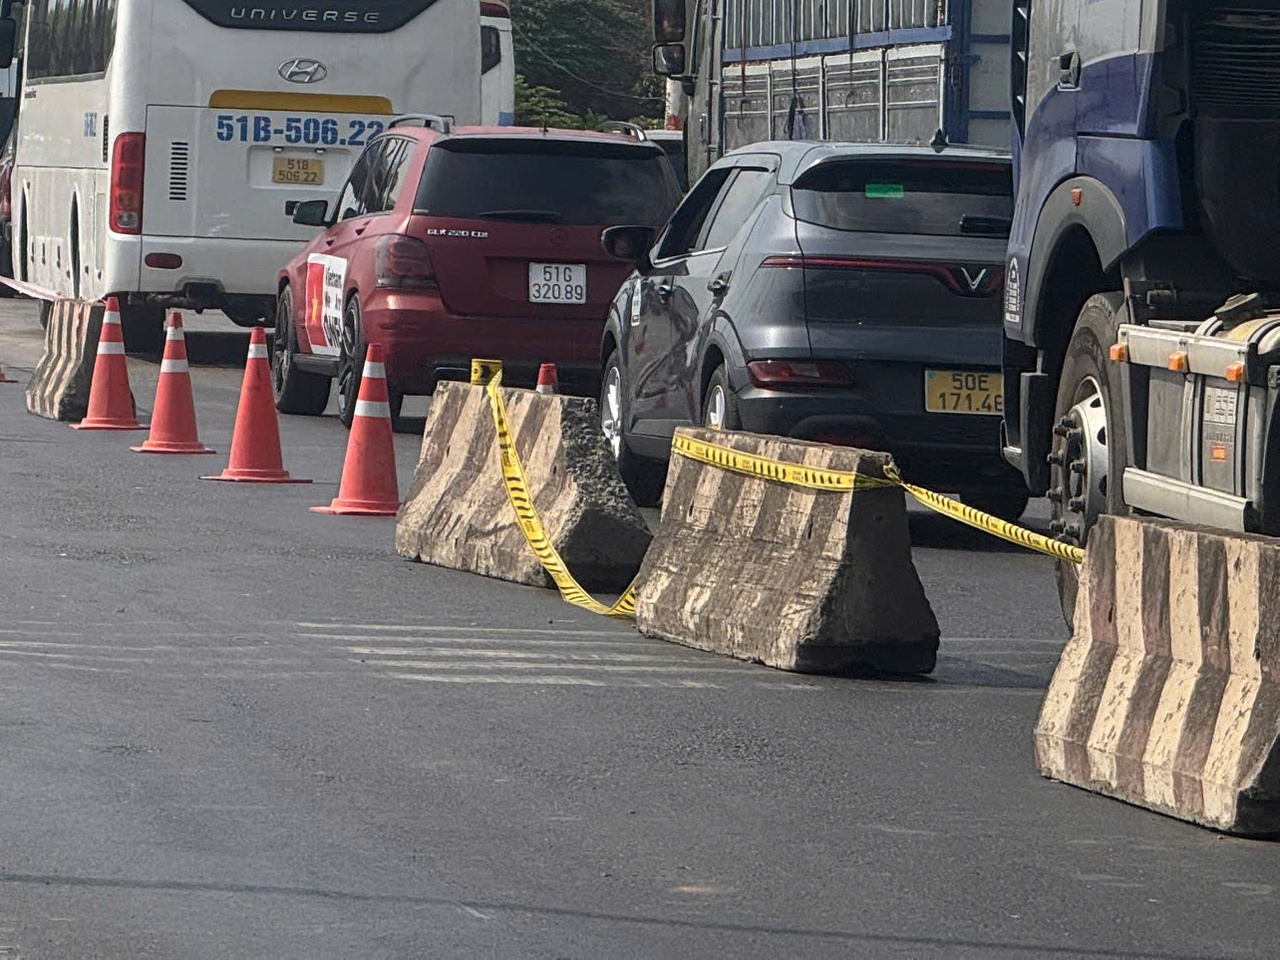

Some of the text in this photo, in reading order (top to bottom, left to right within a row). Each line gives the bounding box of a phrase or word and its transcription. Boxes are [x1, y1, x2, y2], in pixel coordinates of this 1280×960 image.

[230, 7, 380, 23] UNIVERSE
[216, 115, 384, 147] 51B-506.22
[286, 159, 310, 171] 51B
[278, 171, 318, 183] 506.22
[427, 228, 488, 238] GLK 220 CDI
[542, 265, 573, 283] 51G
[532, 283, 584, 301] 320.89
[951, 373, 990, 391] 50E
